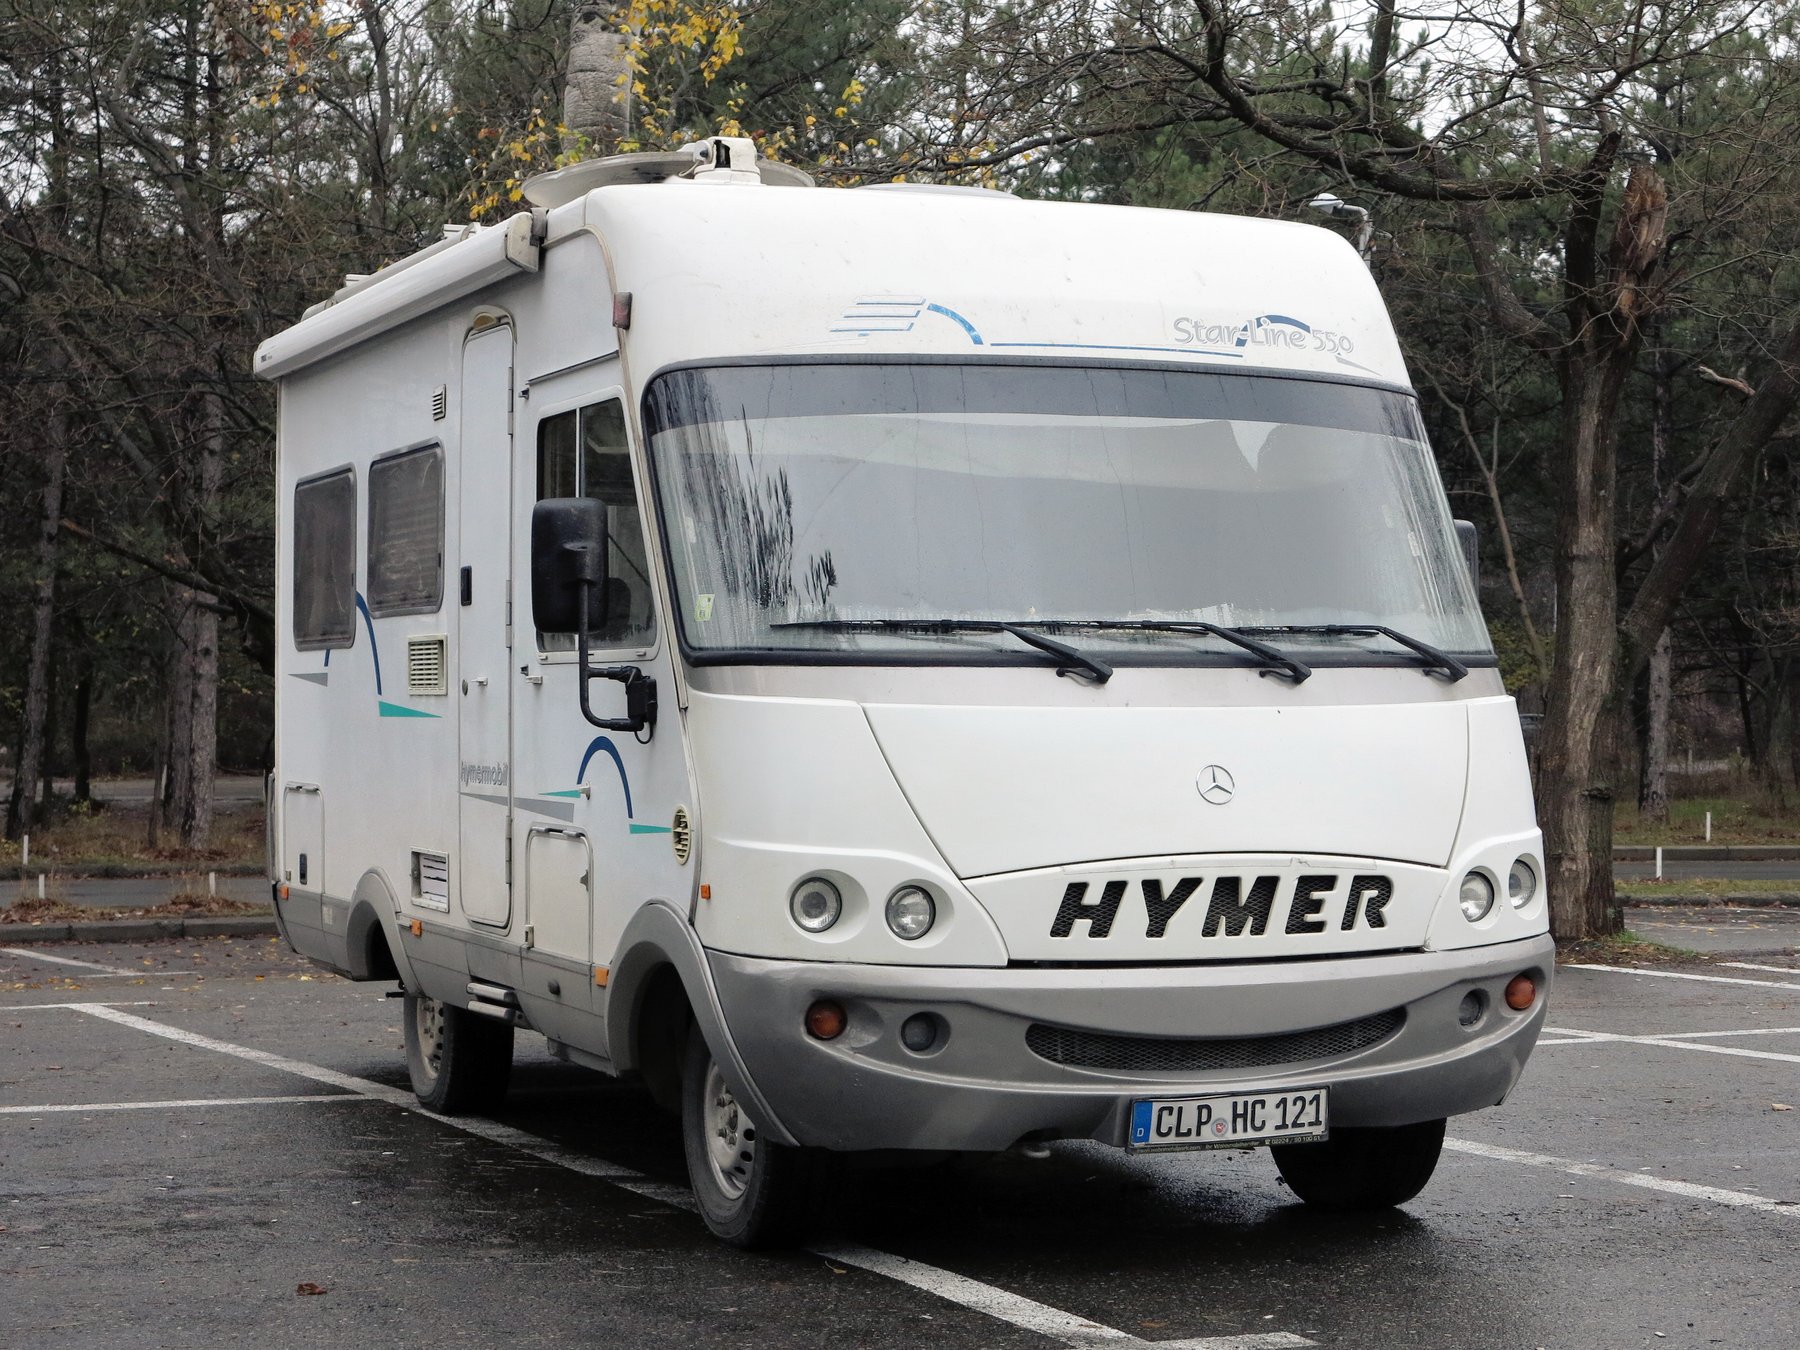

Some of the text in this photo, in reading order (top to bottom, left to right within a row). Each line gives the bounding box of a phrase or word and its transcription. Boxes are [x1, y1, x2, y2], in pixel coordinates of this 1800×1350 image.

[1312, 329, 1354, 354] 550
[1050, 875, 1394, 938] HYMER
[1137, 1127, 1144, 1136] D
[1155, 1093, 1322, 1138] CLP HC 121
